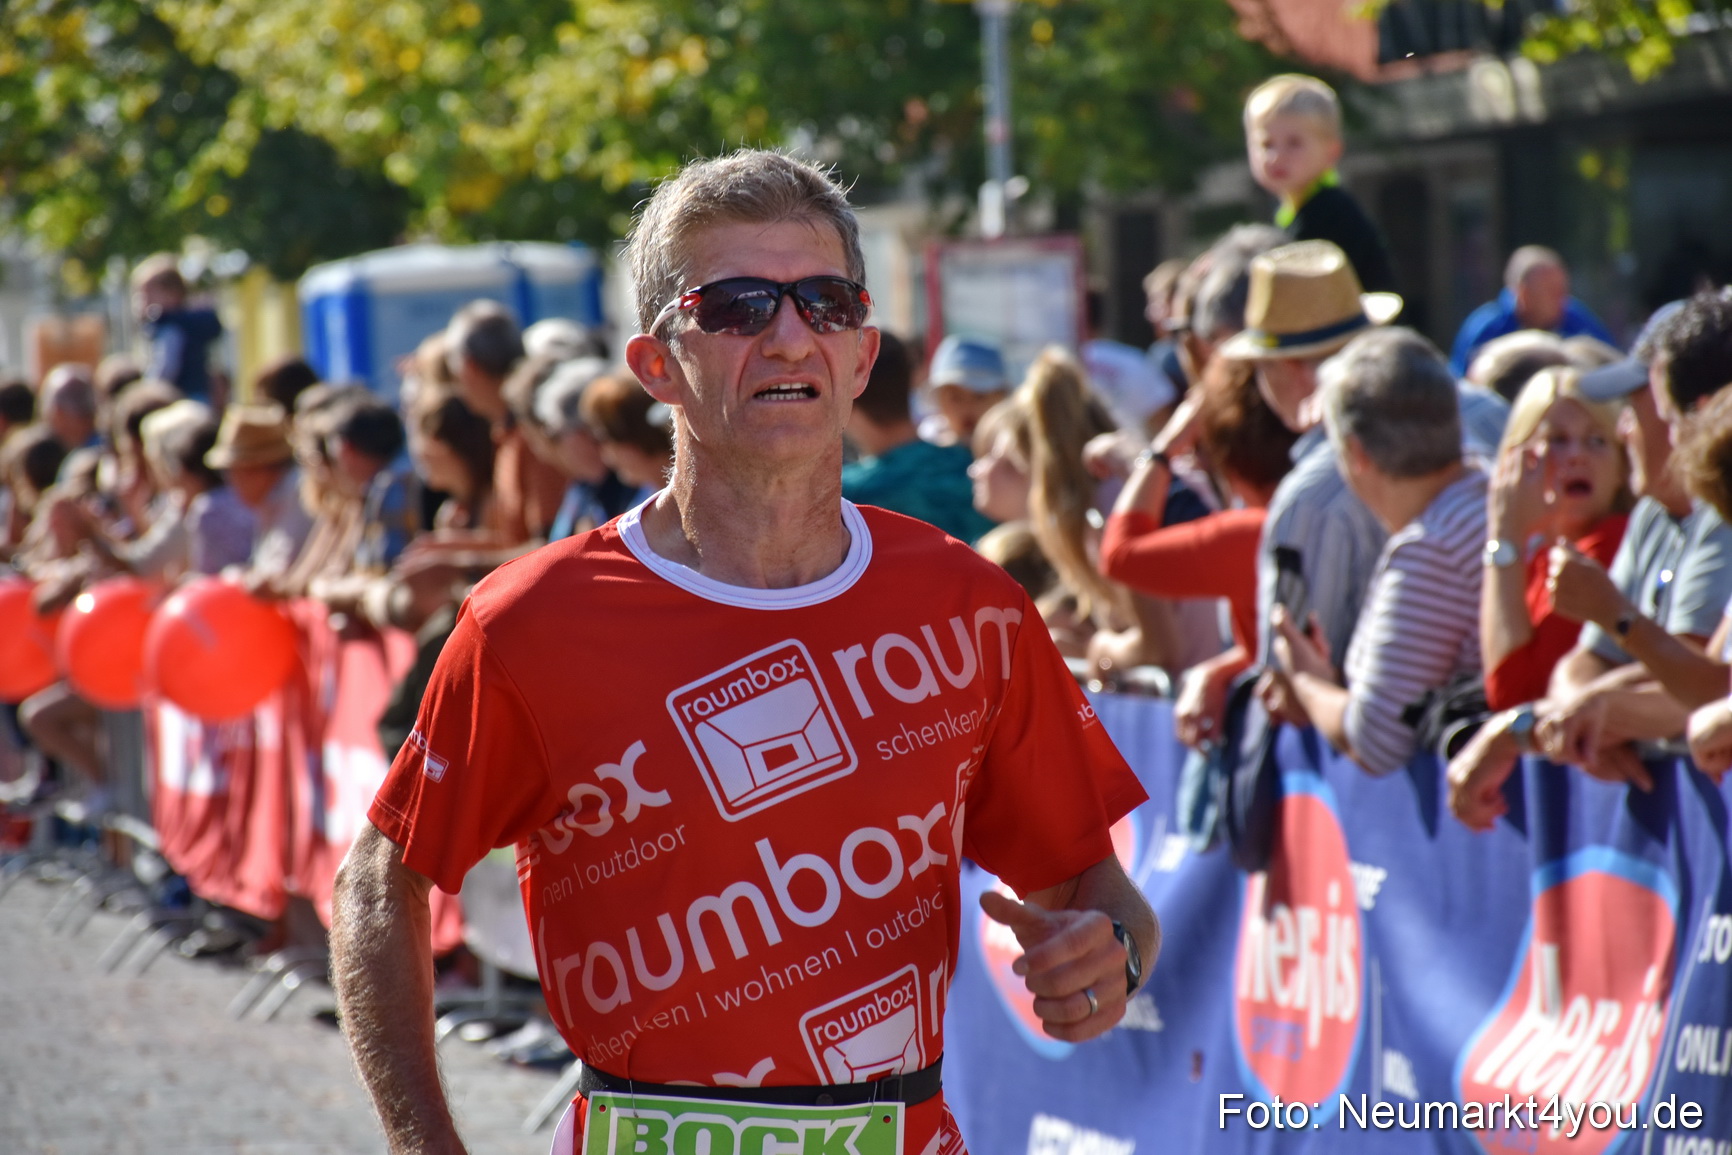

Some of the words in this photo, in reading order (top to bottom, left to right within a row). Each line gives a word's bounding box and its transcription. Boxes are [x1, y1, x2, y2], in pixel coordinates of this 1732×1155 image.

[681, 654, 805, 723] raumbox
[876, 708, 982, 761] schenken
[586, 824, 686, 885] outdoor
[552, 801, 948, 1029] raumbox
[714, 946, 842, 1012] wohnen
[812, 981, 914, 1046] raumbox
[614, 1113, 868, 1155] BOCK
